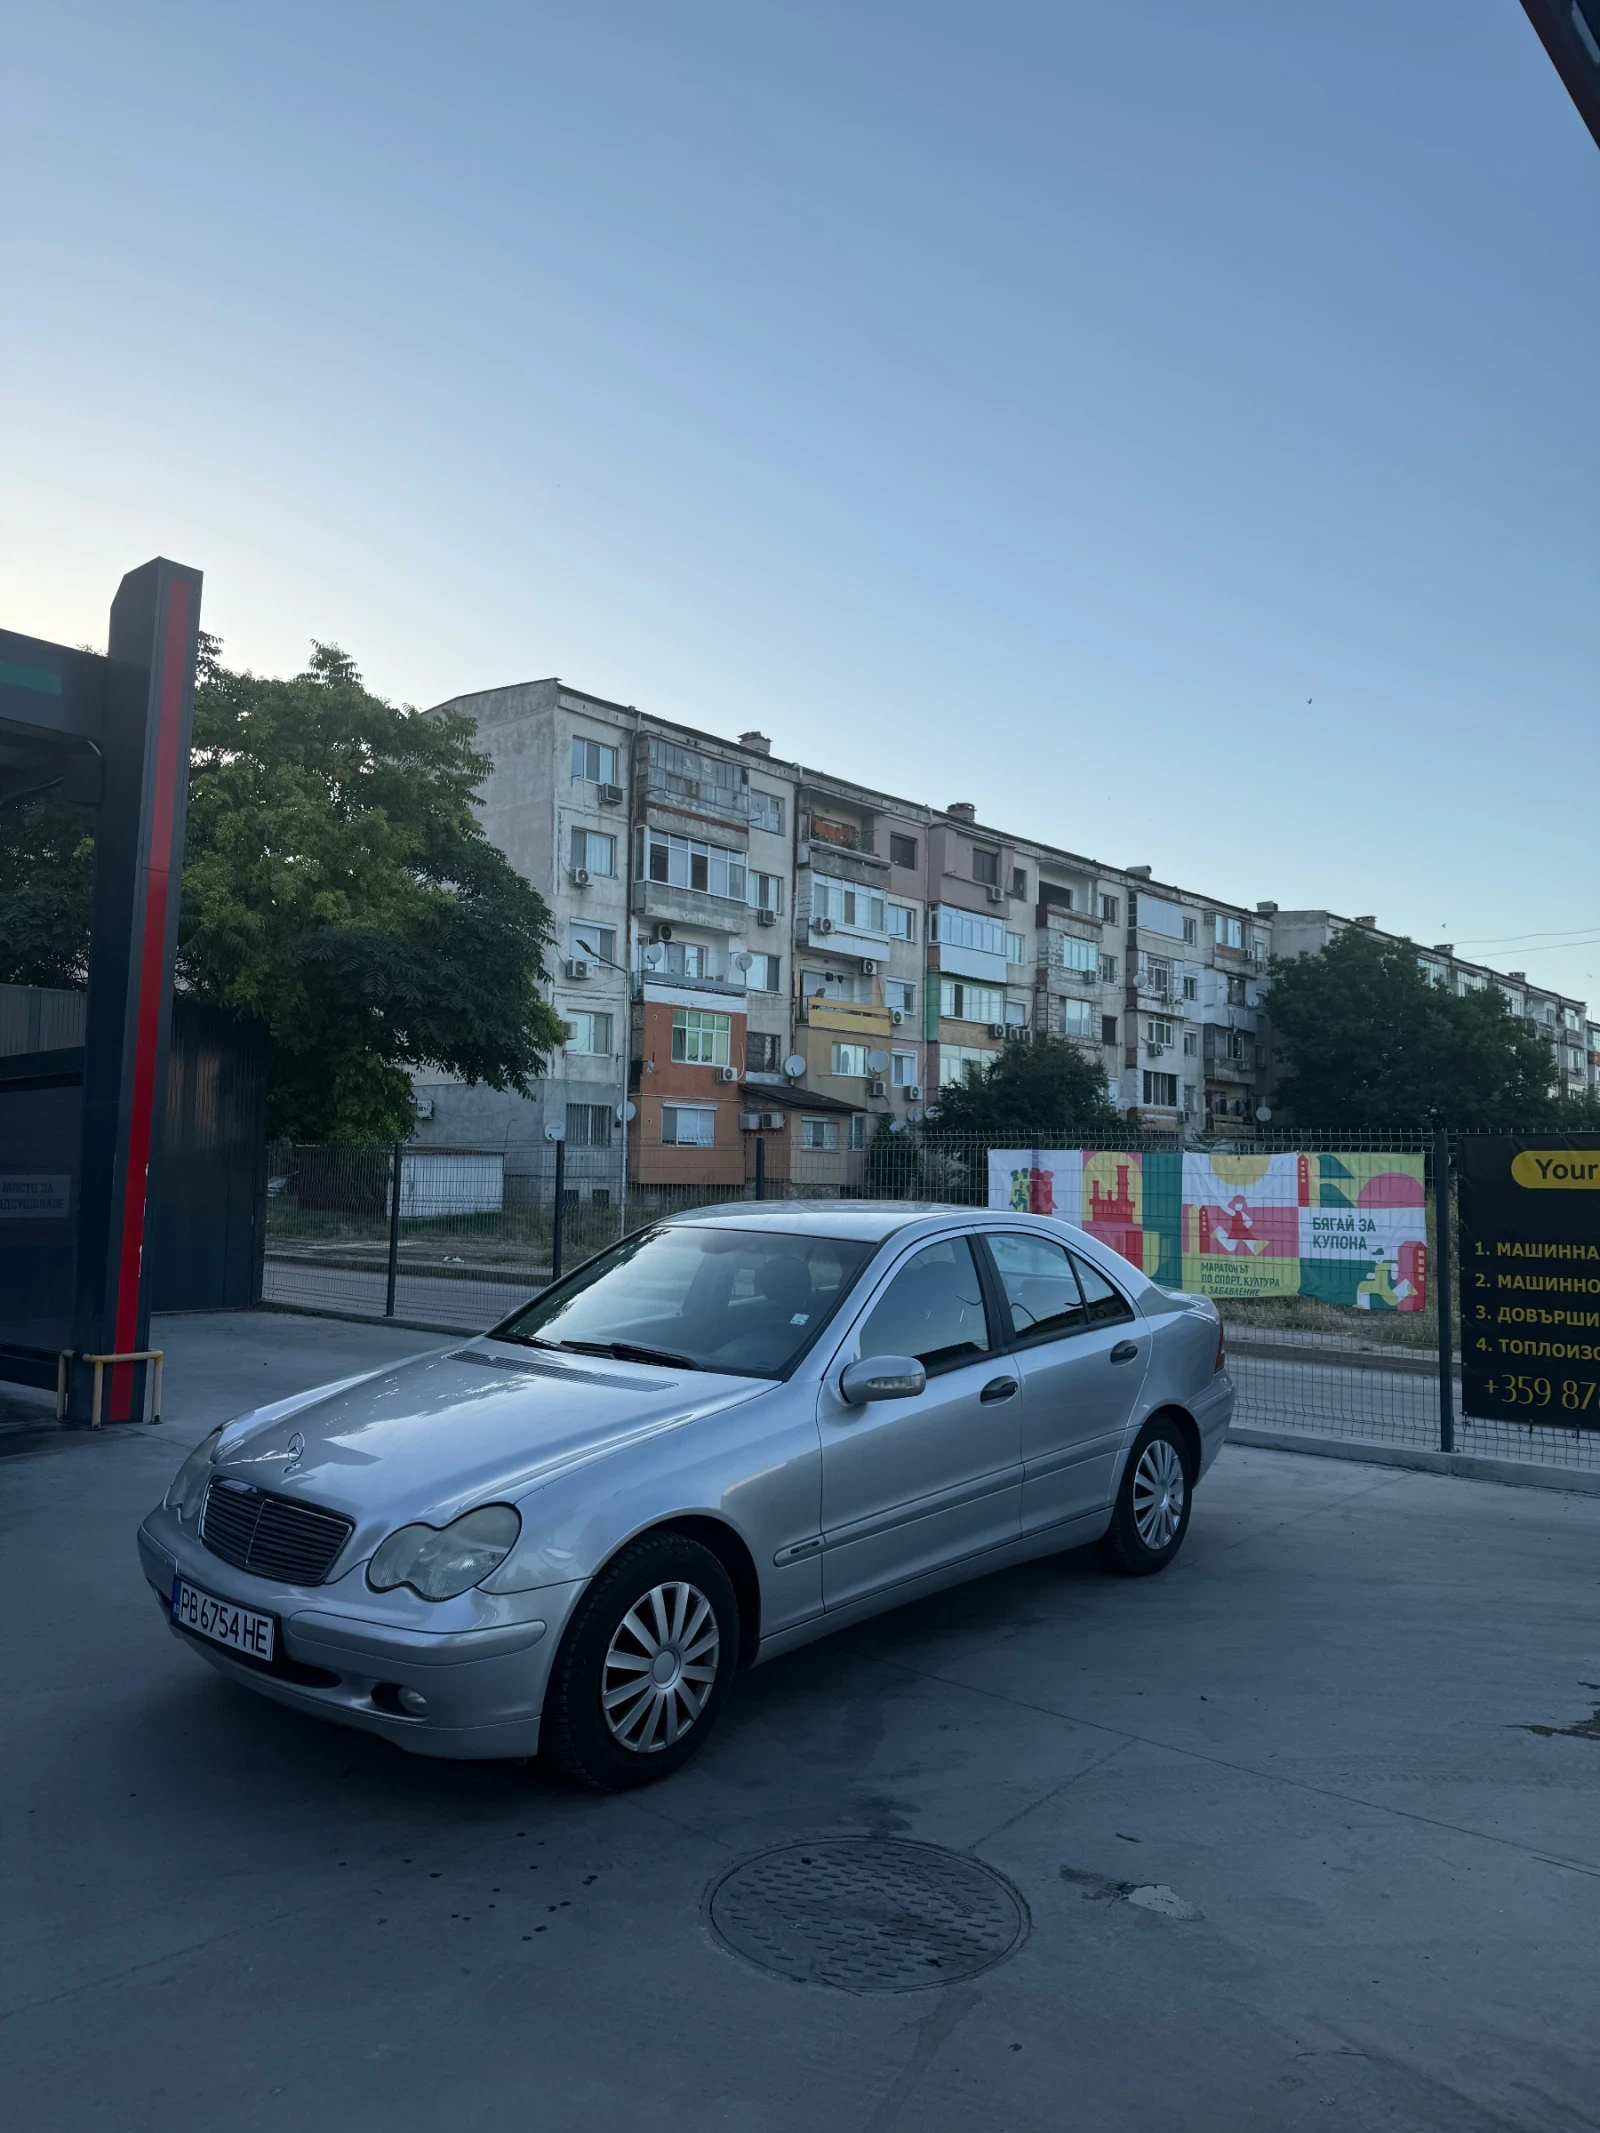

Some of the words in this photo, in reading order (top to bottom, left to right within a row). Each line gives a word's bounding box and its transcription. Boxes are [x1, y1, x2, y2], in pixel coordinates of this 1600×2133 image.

[1535, 1159, 1599, 1180] Your
[40, 1182, 54, 1194] ЗА
[1313, 1215, 1355, 1232] БЯГАЙ
[1358, 1218, 1377, 1232] ЗА
[1313, 1235, 1367, 1250] КУПОНА
[1475, 1241, 1491, 1256] 1.
[1497, 1242, 1600, 1260] МАШИННА
[1201, 1262, 1250, 1274] МАРАТОНЪТ
[1201, 1274, 1213, 1284] ПО
[1214, 1275, 1242, 1286] СПОРТ,
[1243, 1276, 1280, 1288] КУЛТУРА
[1475, 1273, 1492, 1288] 2.
[1497, 1274, 1600, 1294] МАШИННО
[1208, 1285, 1260, 1297] ЗАБАВЛЕНИЕ
[1475, 1305, 1492, 1320] 3.
[1497, 1306, 1600, 1328] ДОВЪРШИ
[1475, 1337, 1493, 1352] 4.
[1484, 1374, 1552, 1406] +359
[1561, 1380, 1600, 1410] 87
[200, 1599, 239, 1643] 6754
